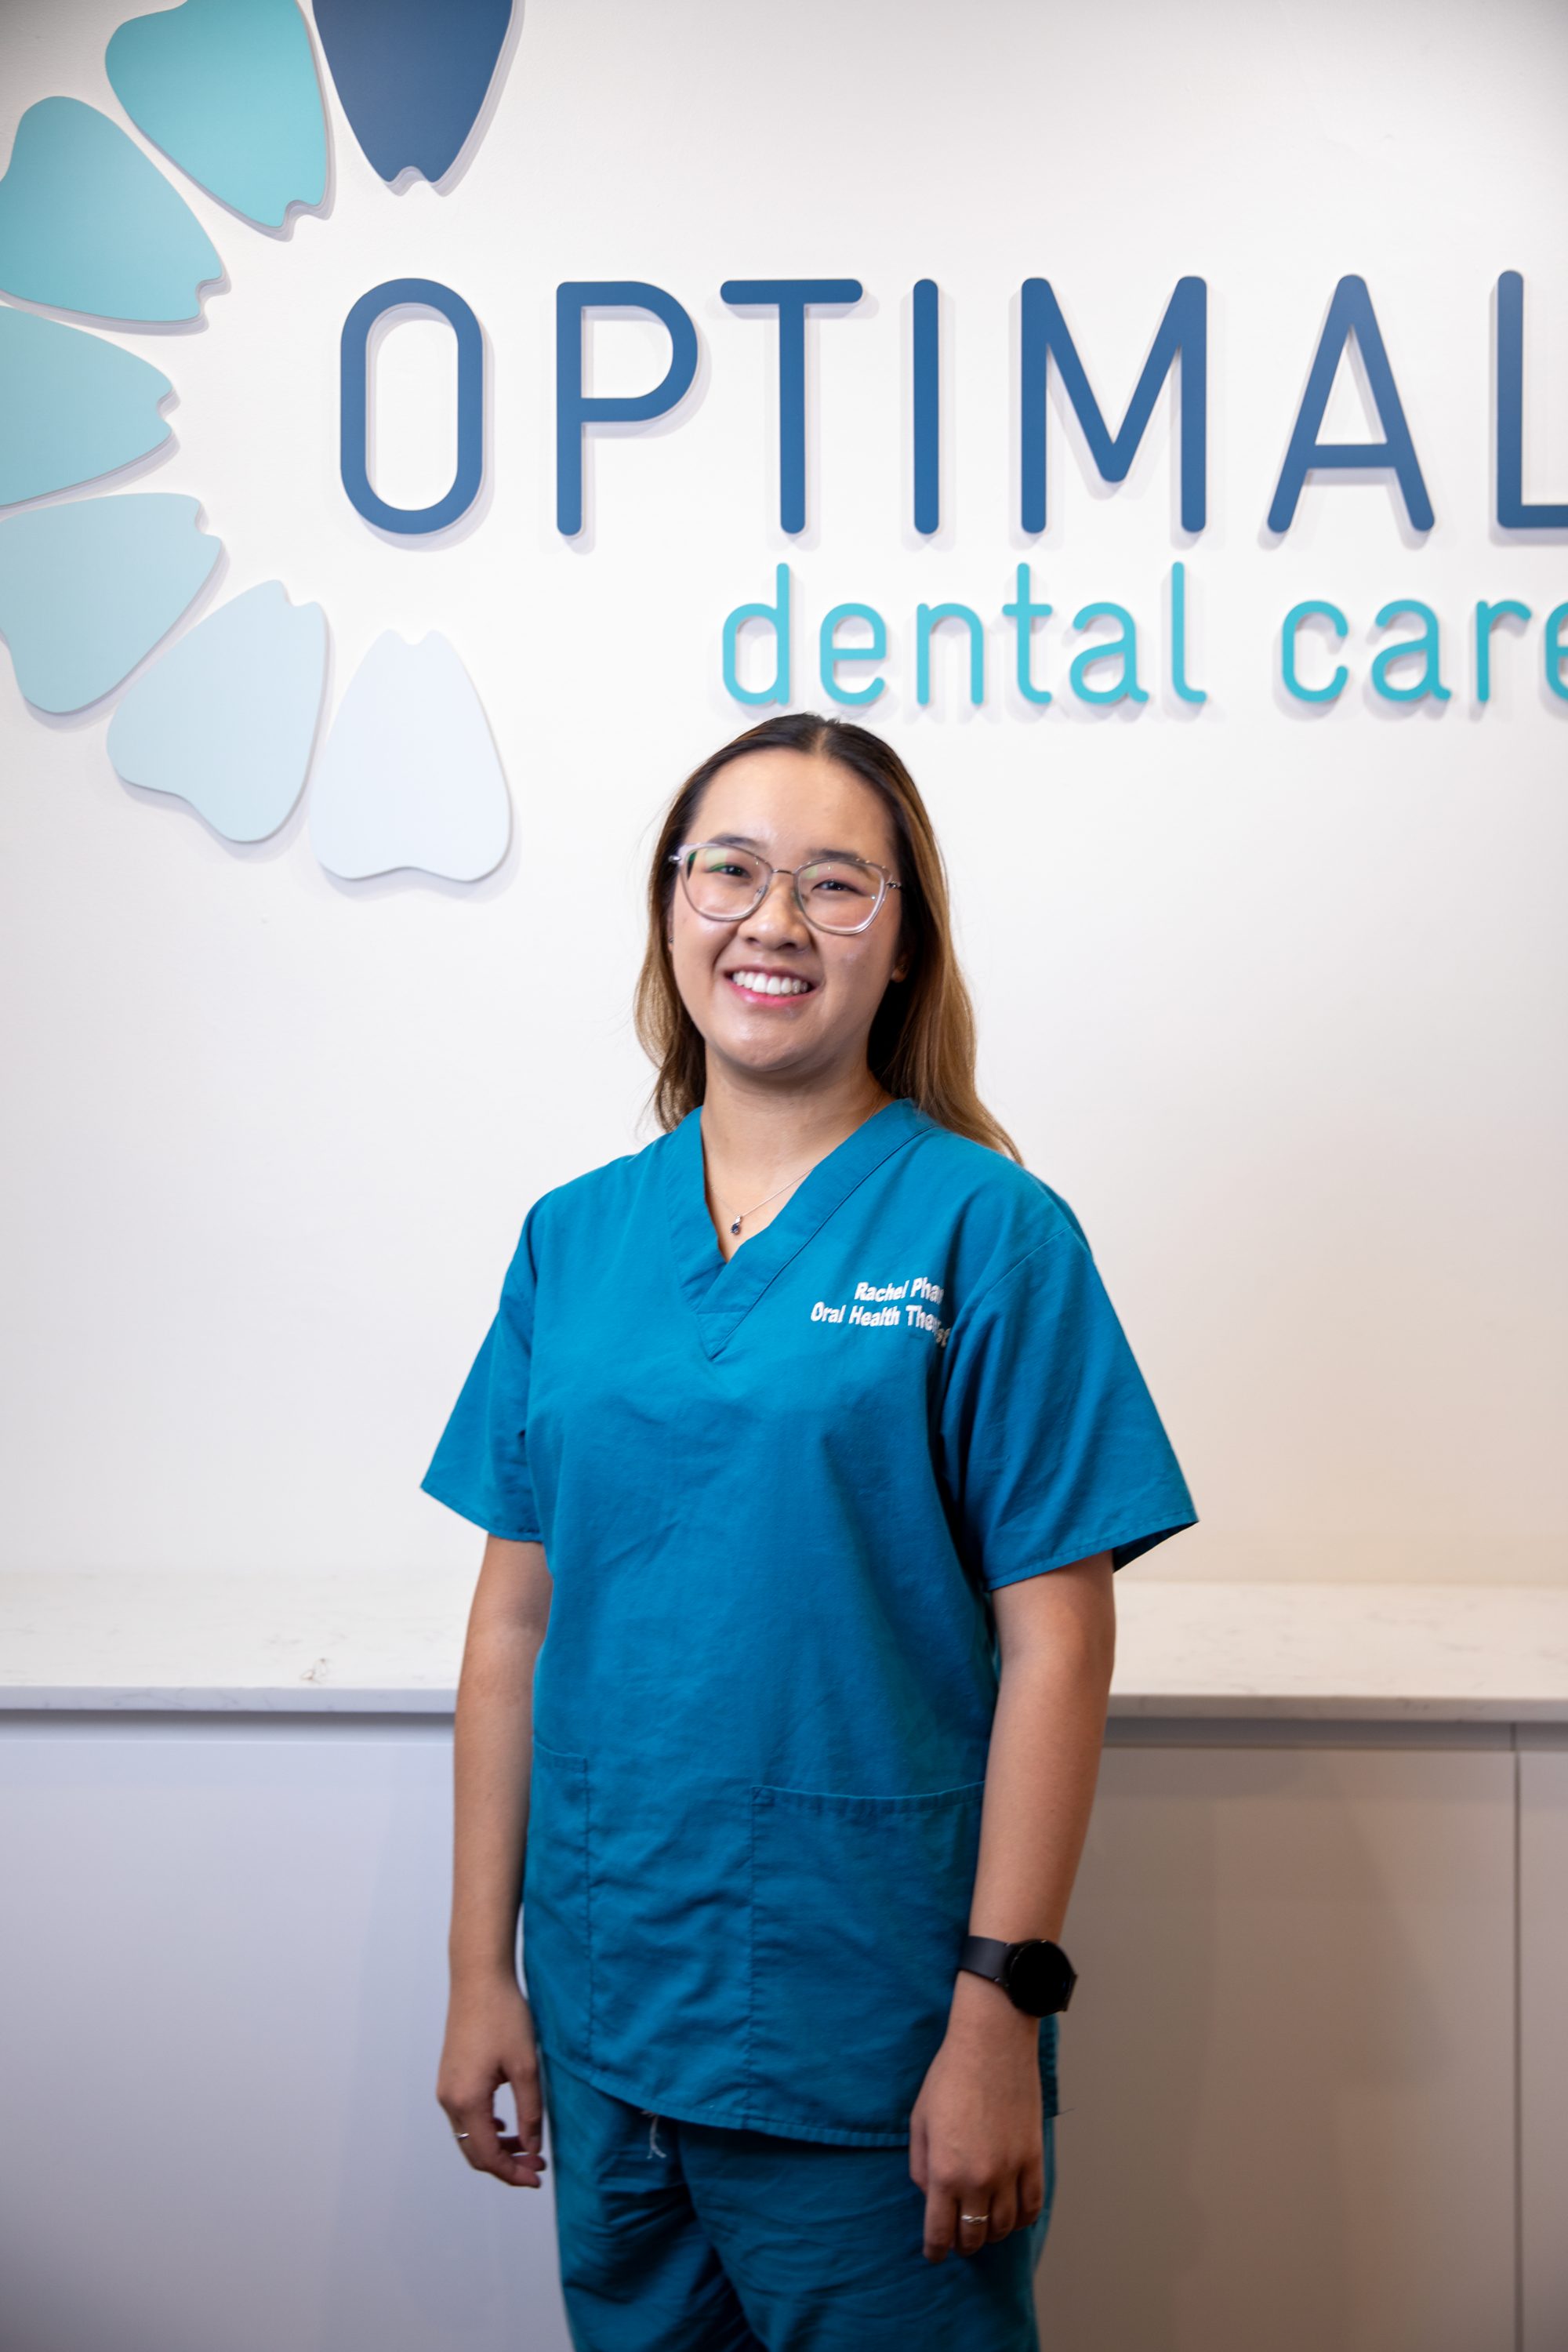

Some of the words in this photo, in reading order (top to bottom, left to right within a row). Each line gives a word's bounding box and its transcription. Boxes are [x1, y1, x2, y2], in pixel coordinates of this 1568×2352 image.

[340, 270, 1568, 536] OPTIMAL
[722, 562, 1207, 706] dental
[810, 1301, 847, 1323] Oral
[848, 1305, 902, 1327] Health
[854, 1279, 909, 1302] Rachel
